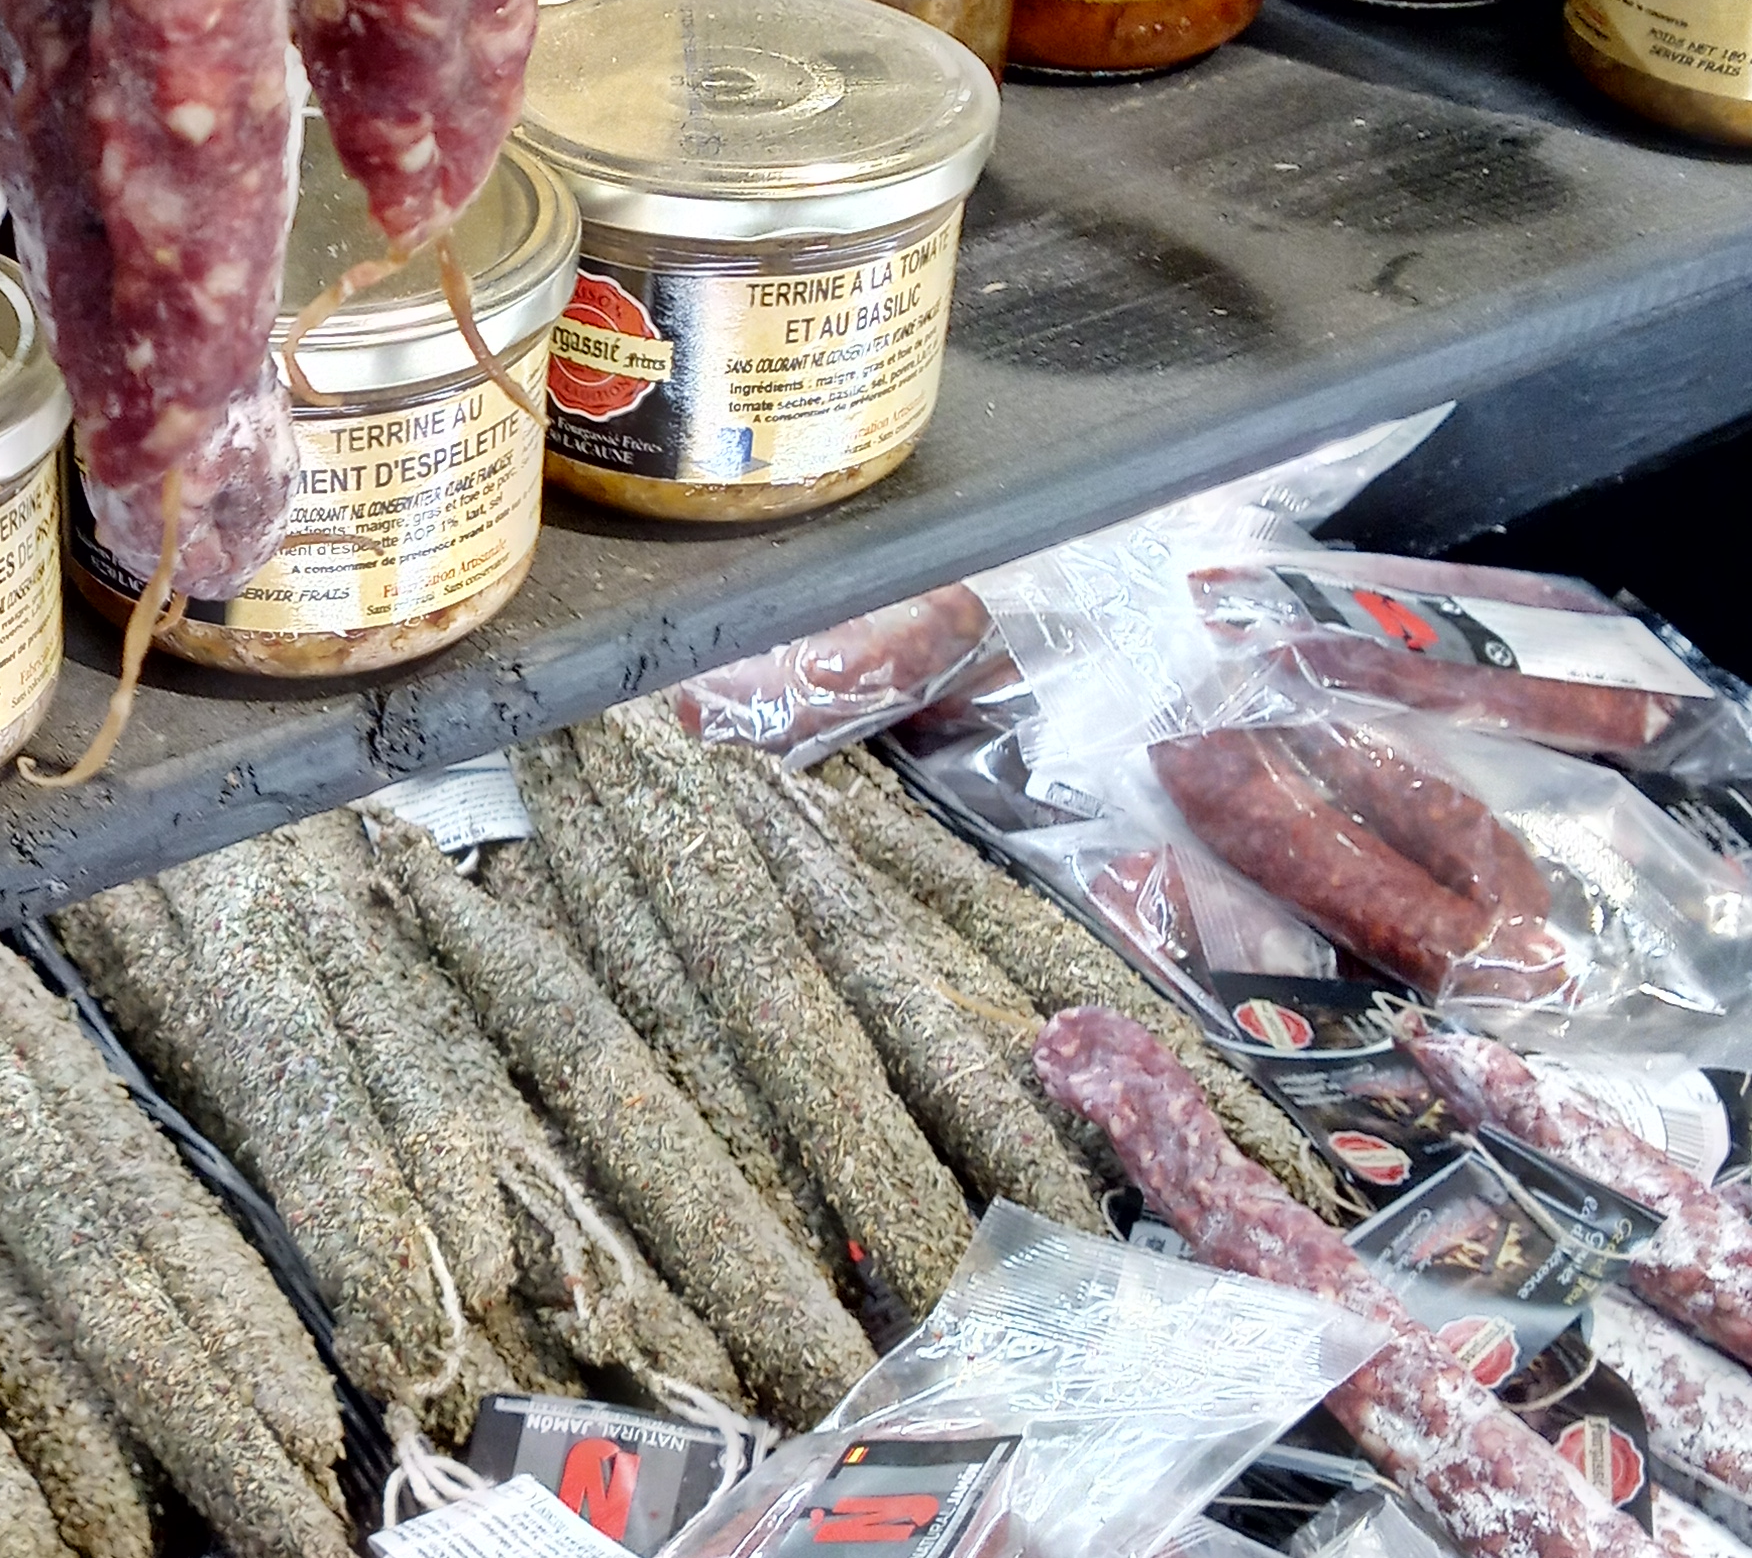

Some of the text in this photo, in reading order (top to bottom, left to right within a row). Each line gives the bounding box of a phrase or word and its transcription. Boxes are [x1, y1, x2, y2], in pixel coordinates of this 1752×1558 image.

[746, 224, 950, 308] TERRINE LA TOMATE
[785, 283, 921, 343] ET AU BASILIC
[755, 354, 810, 374] COLORANT
[730, 381, 804, 397] Ingrédients
[729, 400, 774, 412] tomate
[330, 394, 484, 455] TERRINE AU
[374, 409, 520, 489] D'ESPELETTE
[402, 527, 435, 544] AOP
[298, 586, 350, 602] FRAIS
[525, 1412, 685, 1452] NATURAL JAMÓN
